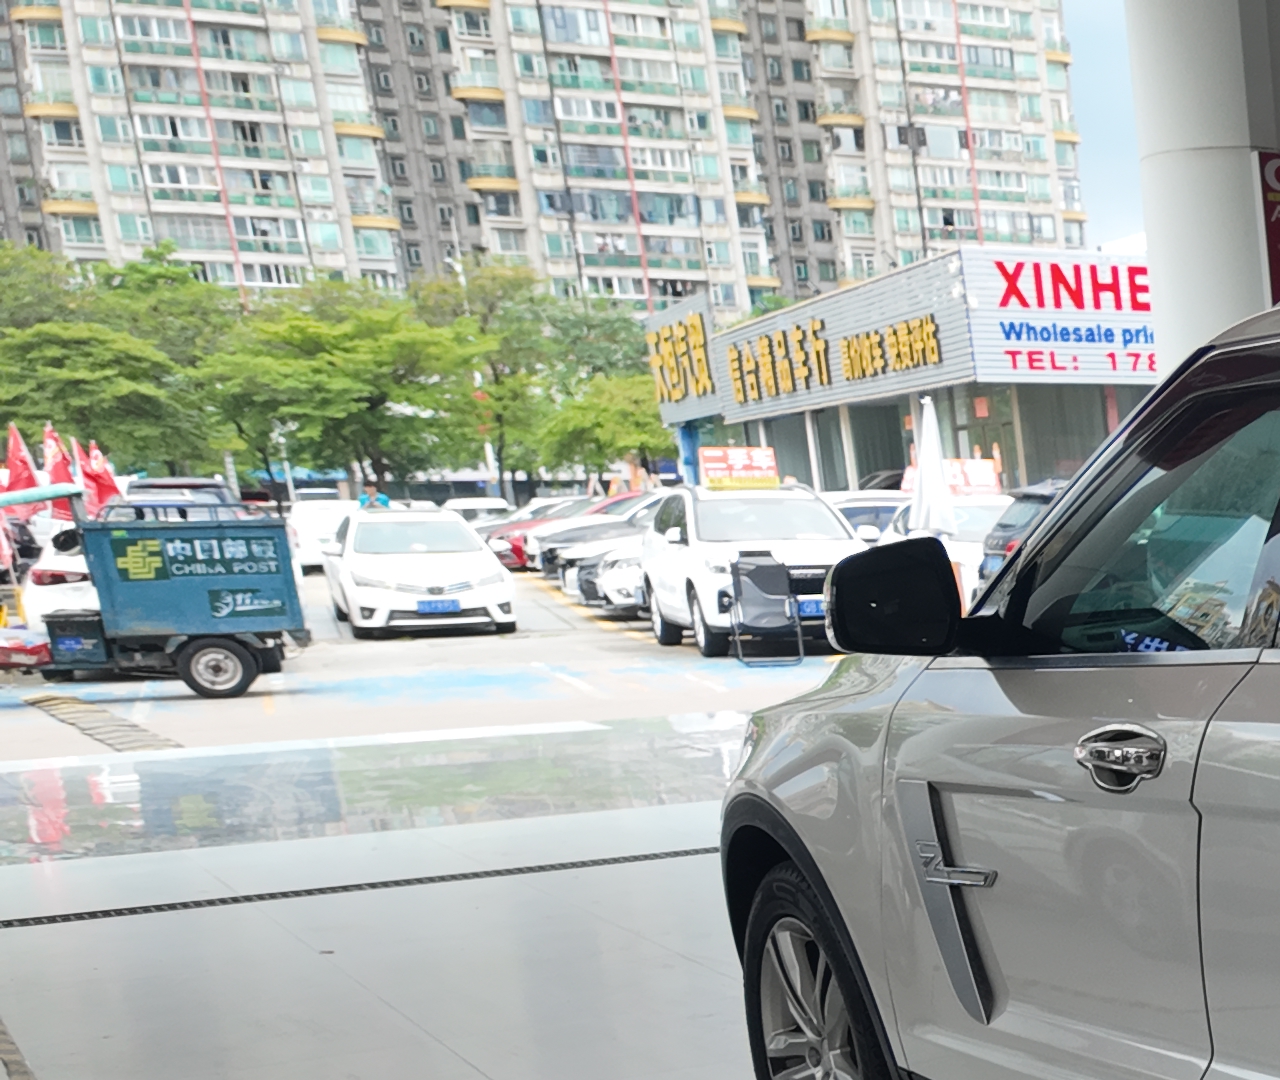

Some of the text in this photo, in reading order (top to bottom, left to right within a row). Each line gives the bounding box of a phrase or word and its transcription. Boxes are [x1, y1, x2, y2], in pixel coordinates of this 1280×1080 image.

[994, 260, 1151, 311] XINHE
[999, 321, 1154, 349] Wholesale pri
[1004, 350, 1079, 371] TEL:
[166, 538, 277, 560] 中国邮政
[232, 561, 279, 573] POST
